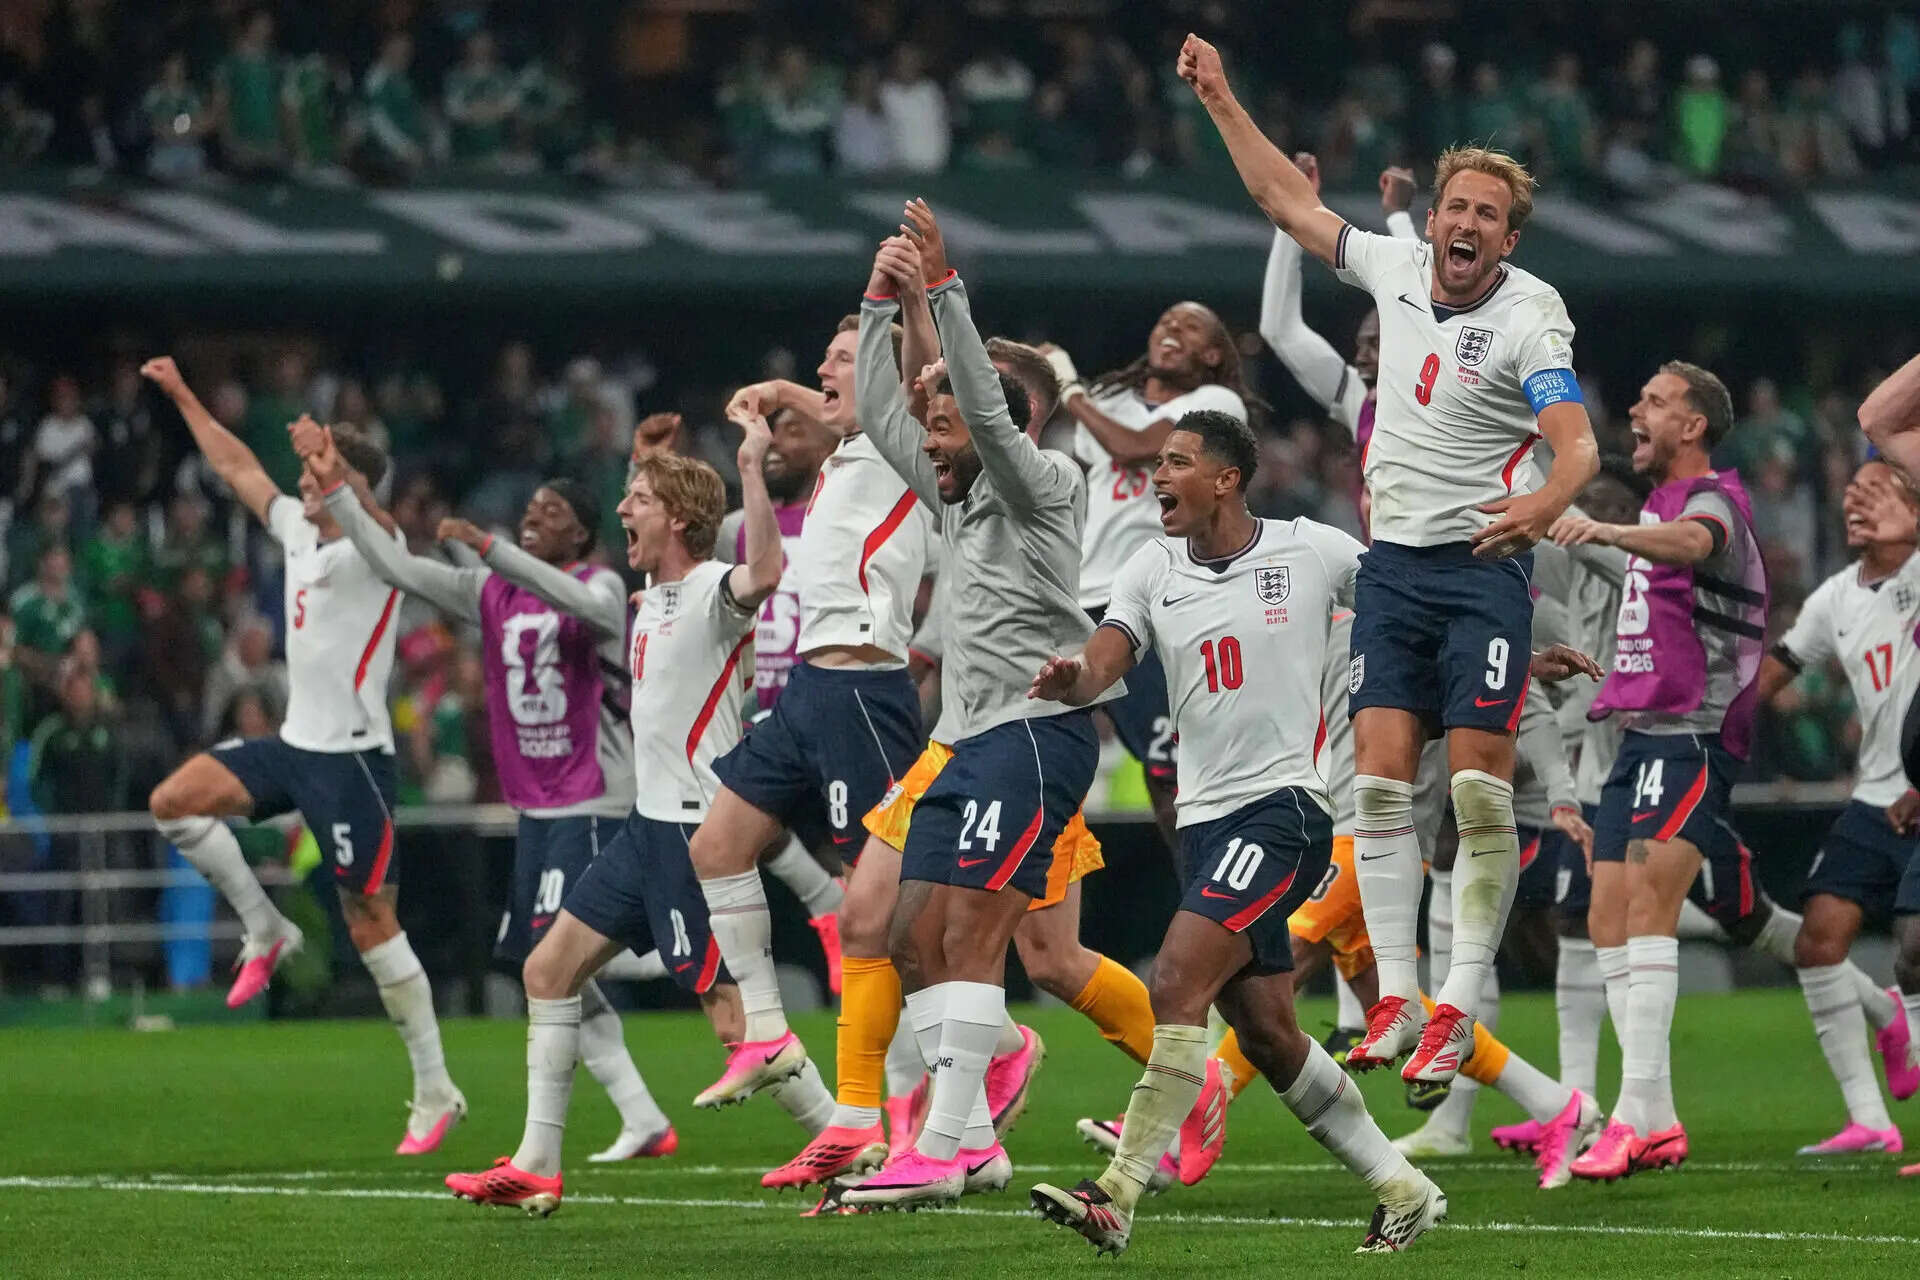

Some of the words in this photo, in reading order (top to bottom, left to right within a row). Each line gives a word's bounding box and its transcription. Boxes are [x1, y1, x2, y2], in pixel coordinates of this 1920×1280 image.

[1415, 353, 1440, 406] 9
[1528, 371, 1561, 386] FOOTBALL
[1530, 378, 1566, 396] UNITES
[1545, 386, 1569, 397] World
[294, 589, 306, 629] 5
[1264, 608, 1288, 616] MEXICO
[1200, 636, 1243, 693] 10
[1485, 637, 1510, 690] 9
[1613, 652, 1655, 673] 026
[1864, 642, 1893, 692] 17
[1148, 715, 1179, 762] 2
[829, 779, 848, 829] 8
[1632, 758, 1664, 808] 14
[332, 822, 354, 867] 5
[958, 799, 1002, 852] 24
[1211, 837, 1264, 891] 10
